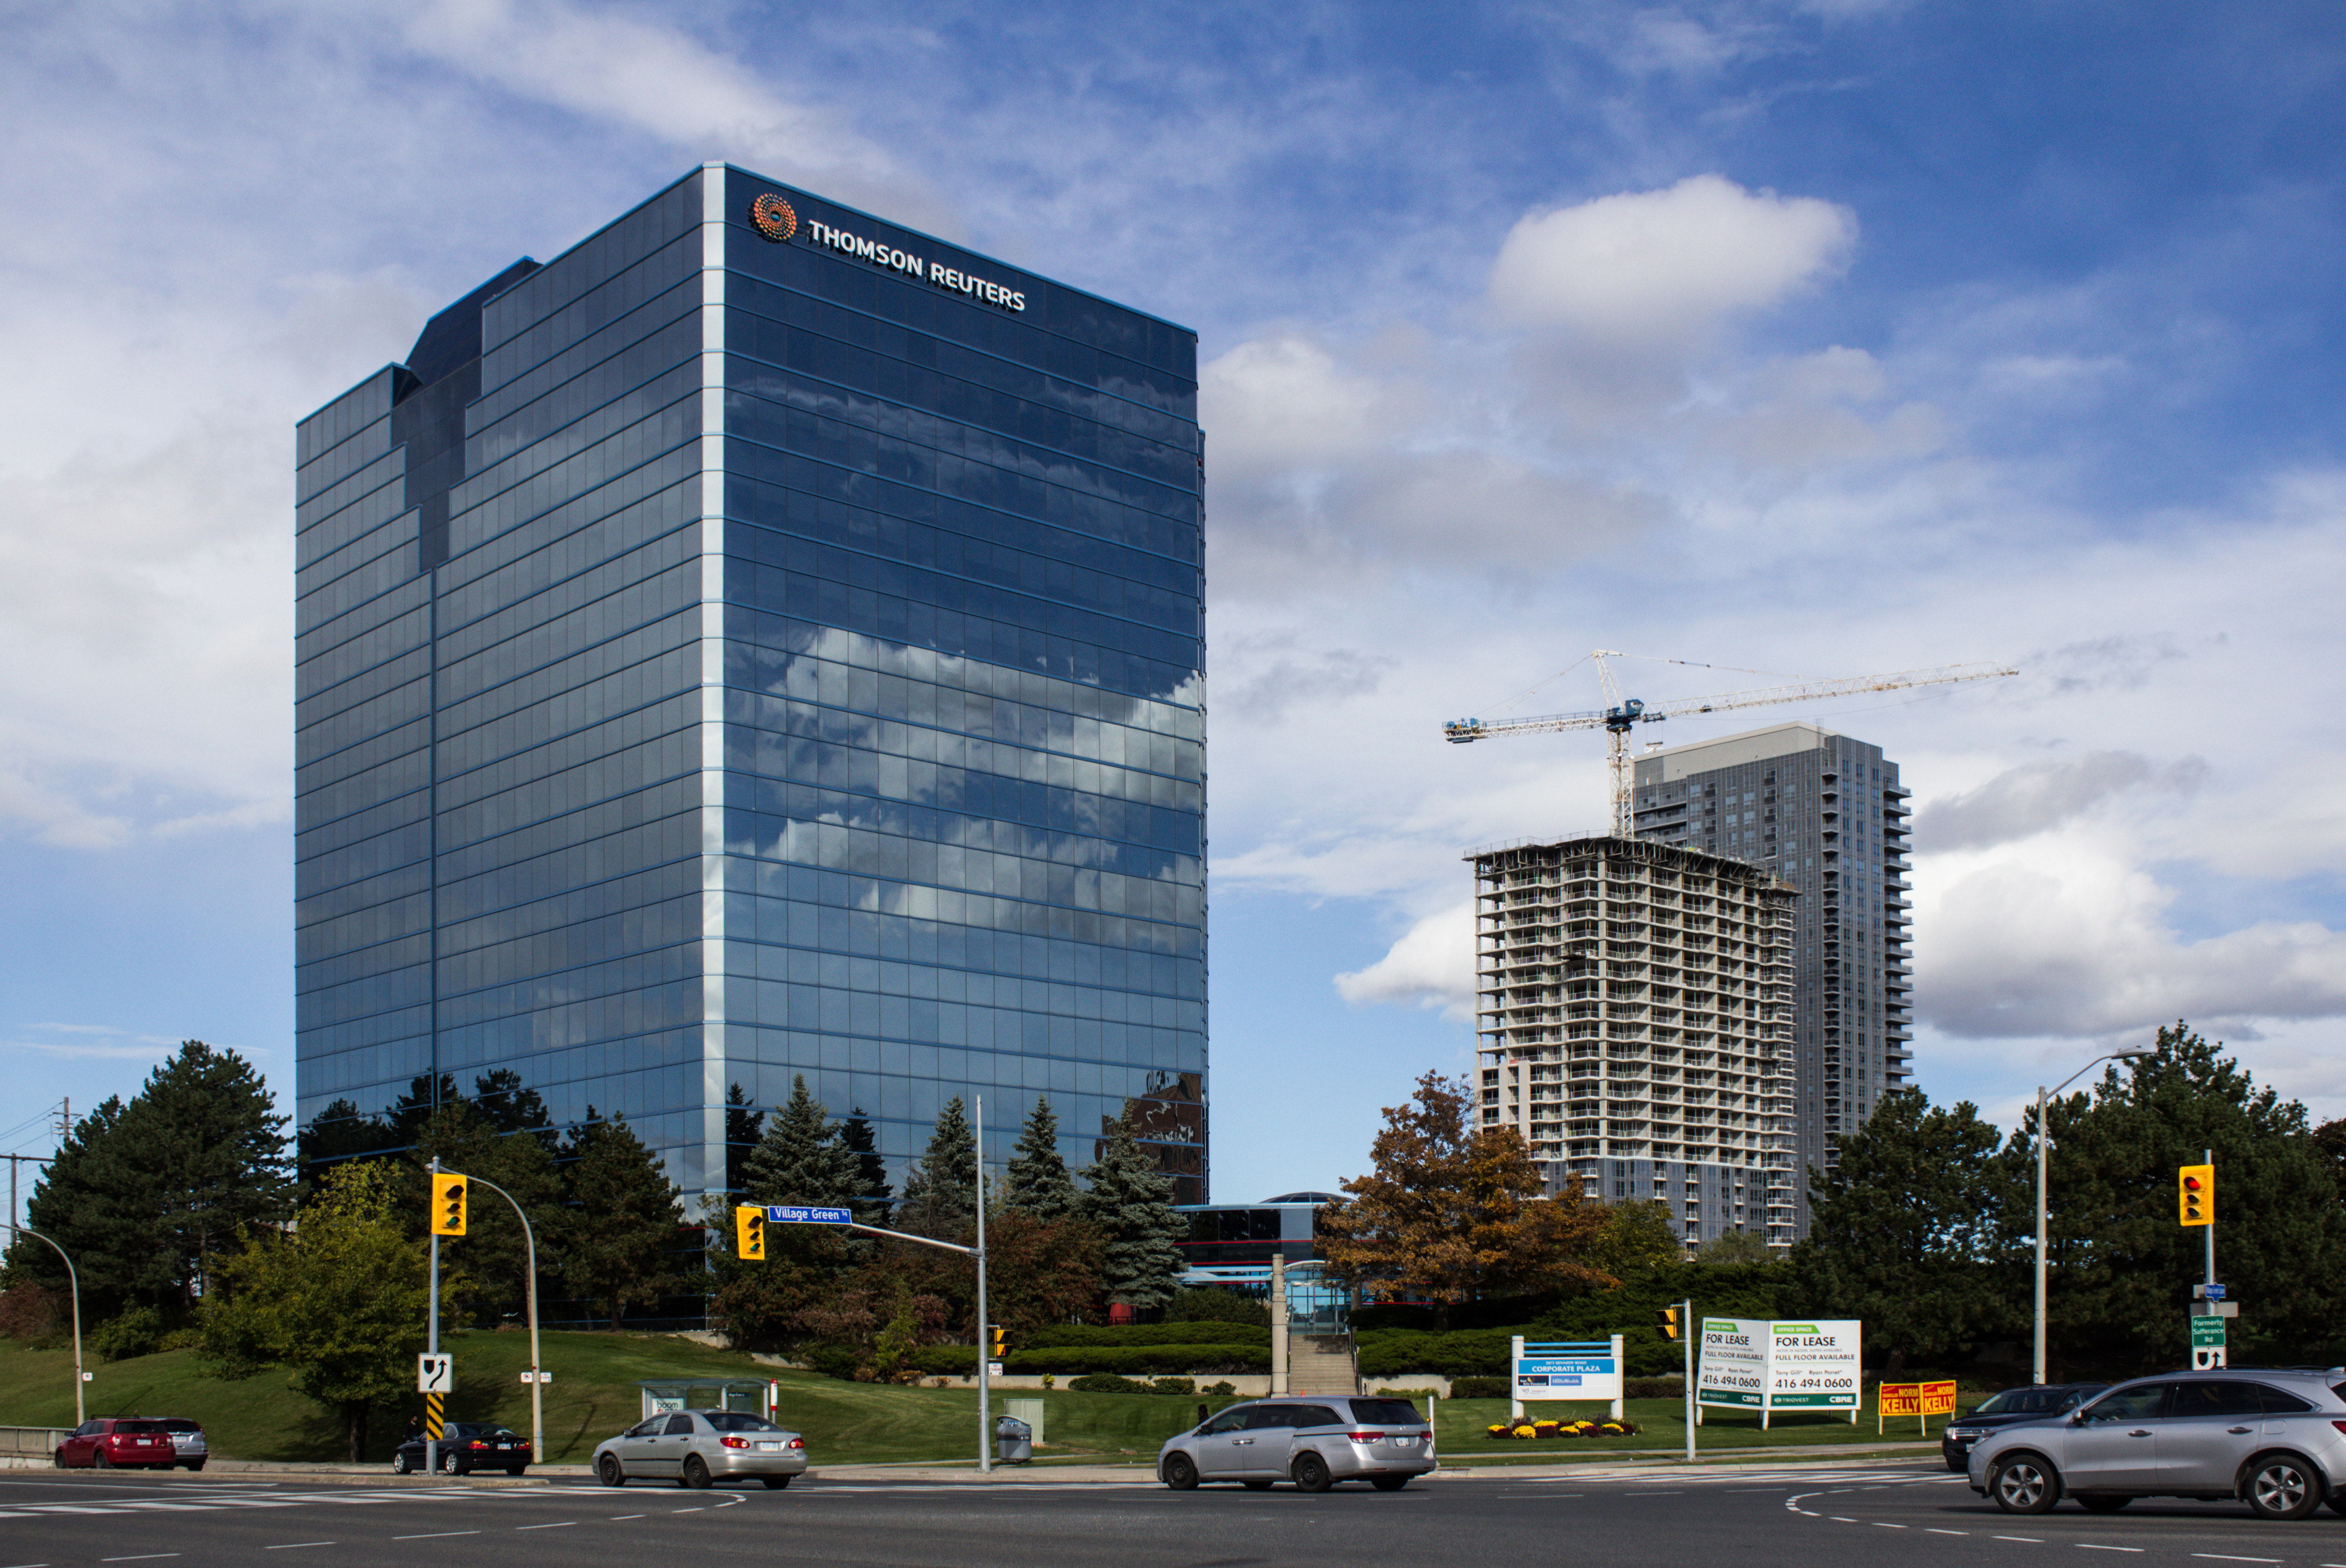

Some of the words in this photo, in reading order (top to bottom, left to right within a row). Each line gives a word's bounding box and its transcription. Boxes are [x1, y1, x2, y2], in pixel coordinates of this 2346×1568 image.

[808, 220, 922, 276] THOMSON
[931, 262, 1025, 311] REUTERS
[775, 1207, 808, 1221] Village
[812, 1209, 839, 1220] Green
[1706, 1333, 1722, 1343] FOR
[1725, 1335, 1750, 1345] LEASE
[1776, 1337, 1799, 1346] FOR
[1803, 1337, 1835, 1346] LEASE
[1703, 1374, 1718, 1384] 416
[1720, 1376, 1737, 1385] 494
[1739, 1377, 1760, 1388] 0600
[1775, 1379, 1796, 1388] 416
[1800, 1378, 1820, 1388] 494
[1824, 1378, 1852, 1388] 0600
[1898, 1388, 1918, 1397] NORM
[1937, 1385, 1953, 1396] NORM
[657, 1400, 678, 1409] boom
[1742, 1395, 1760, 1403] CBRE
[1924, 1395, 1953, 1412] KELLY
[1882, 1398, 1919, 1413] KELLY
